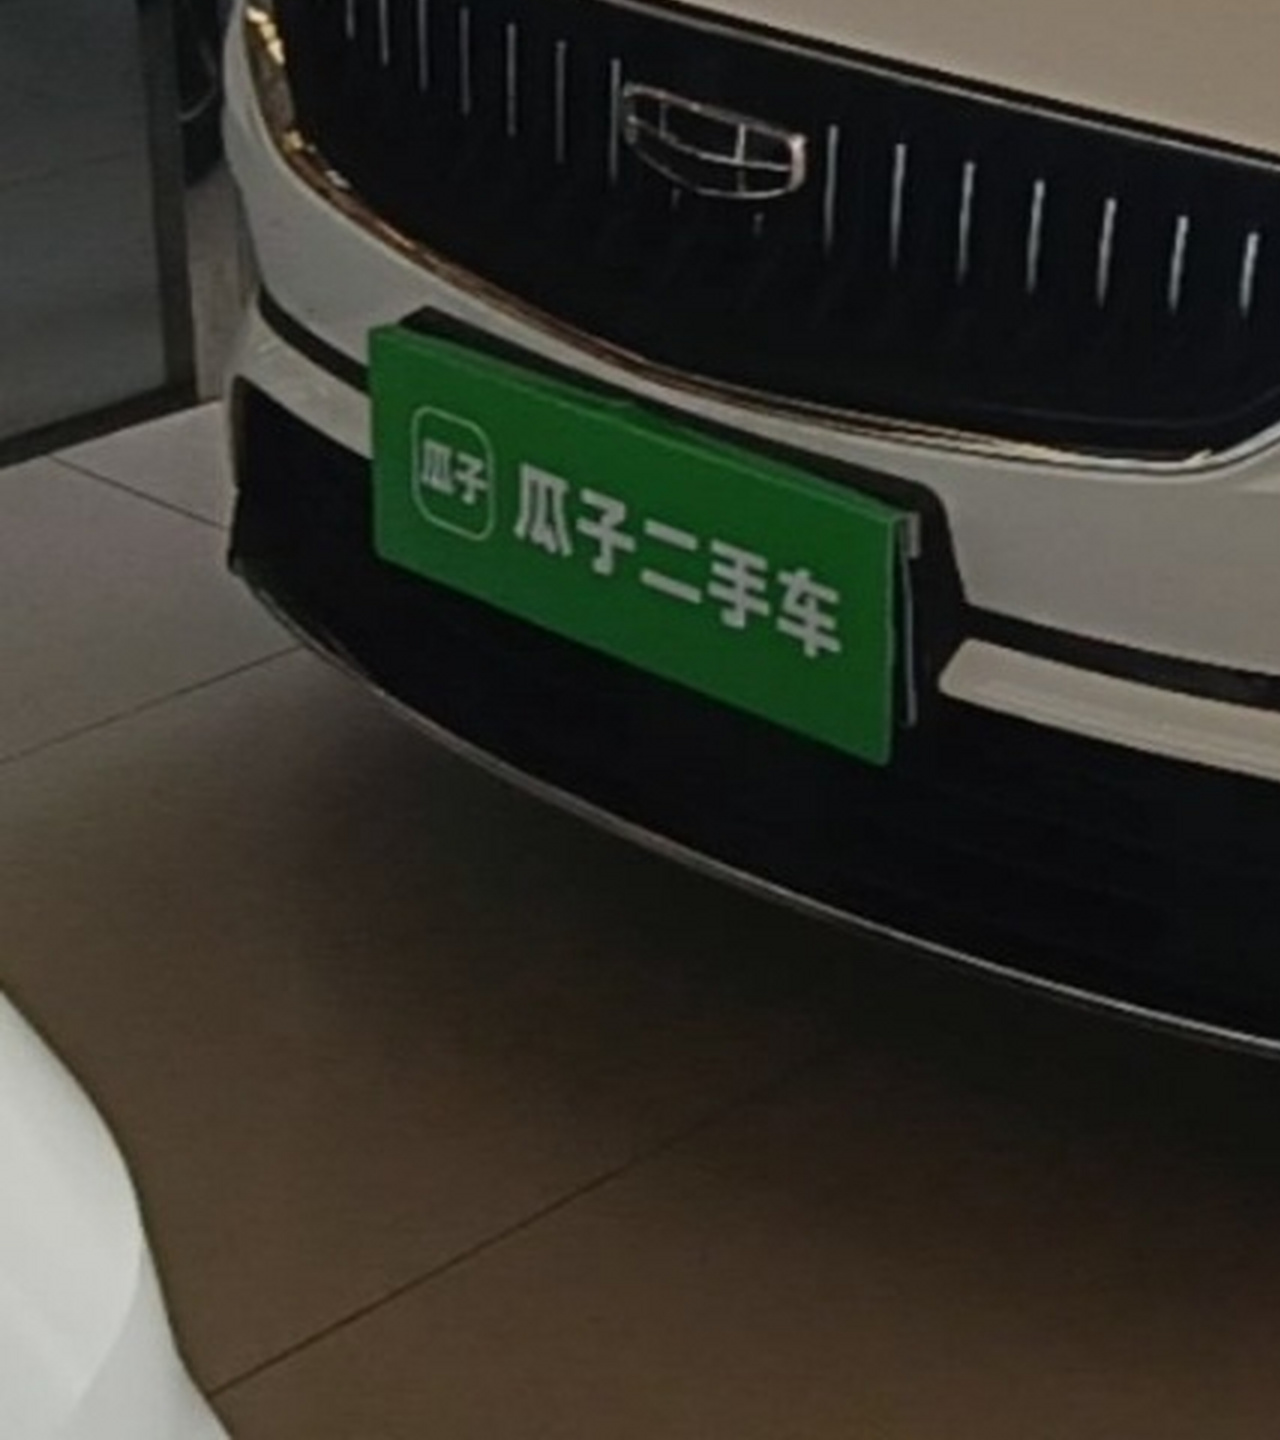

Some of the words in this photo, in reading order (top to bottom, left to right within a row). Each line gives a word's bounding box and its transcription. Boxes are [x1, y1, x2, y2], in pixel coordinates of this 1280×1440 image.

[419, 437, 489, 506] 瓜子
[513, 462, 842, 658] 瓜子二手车
